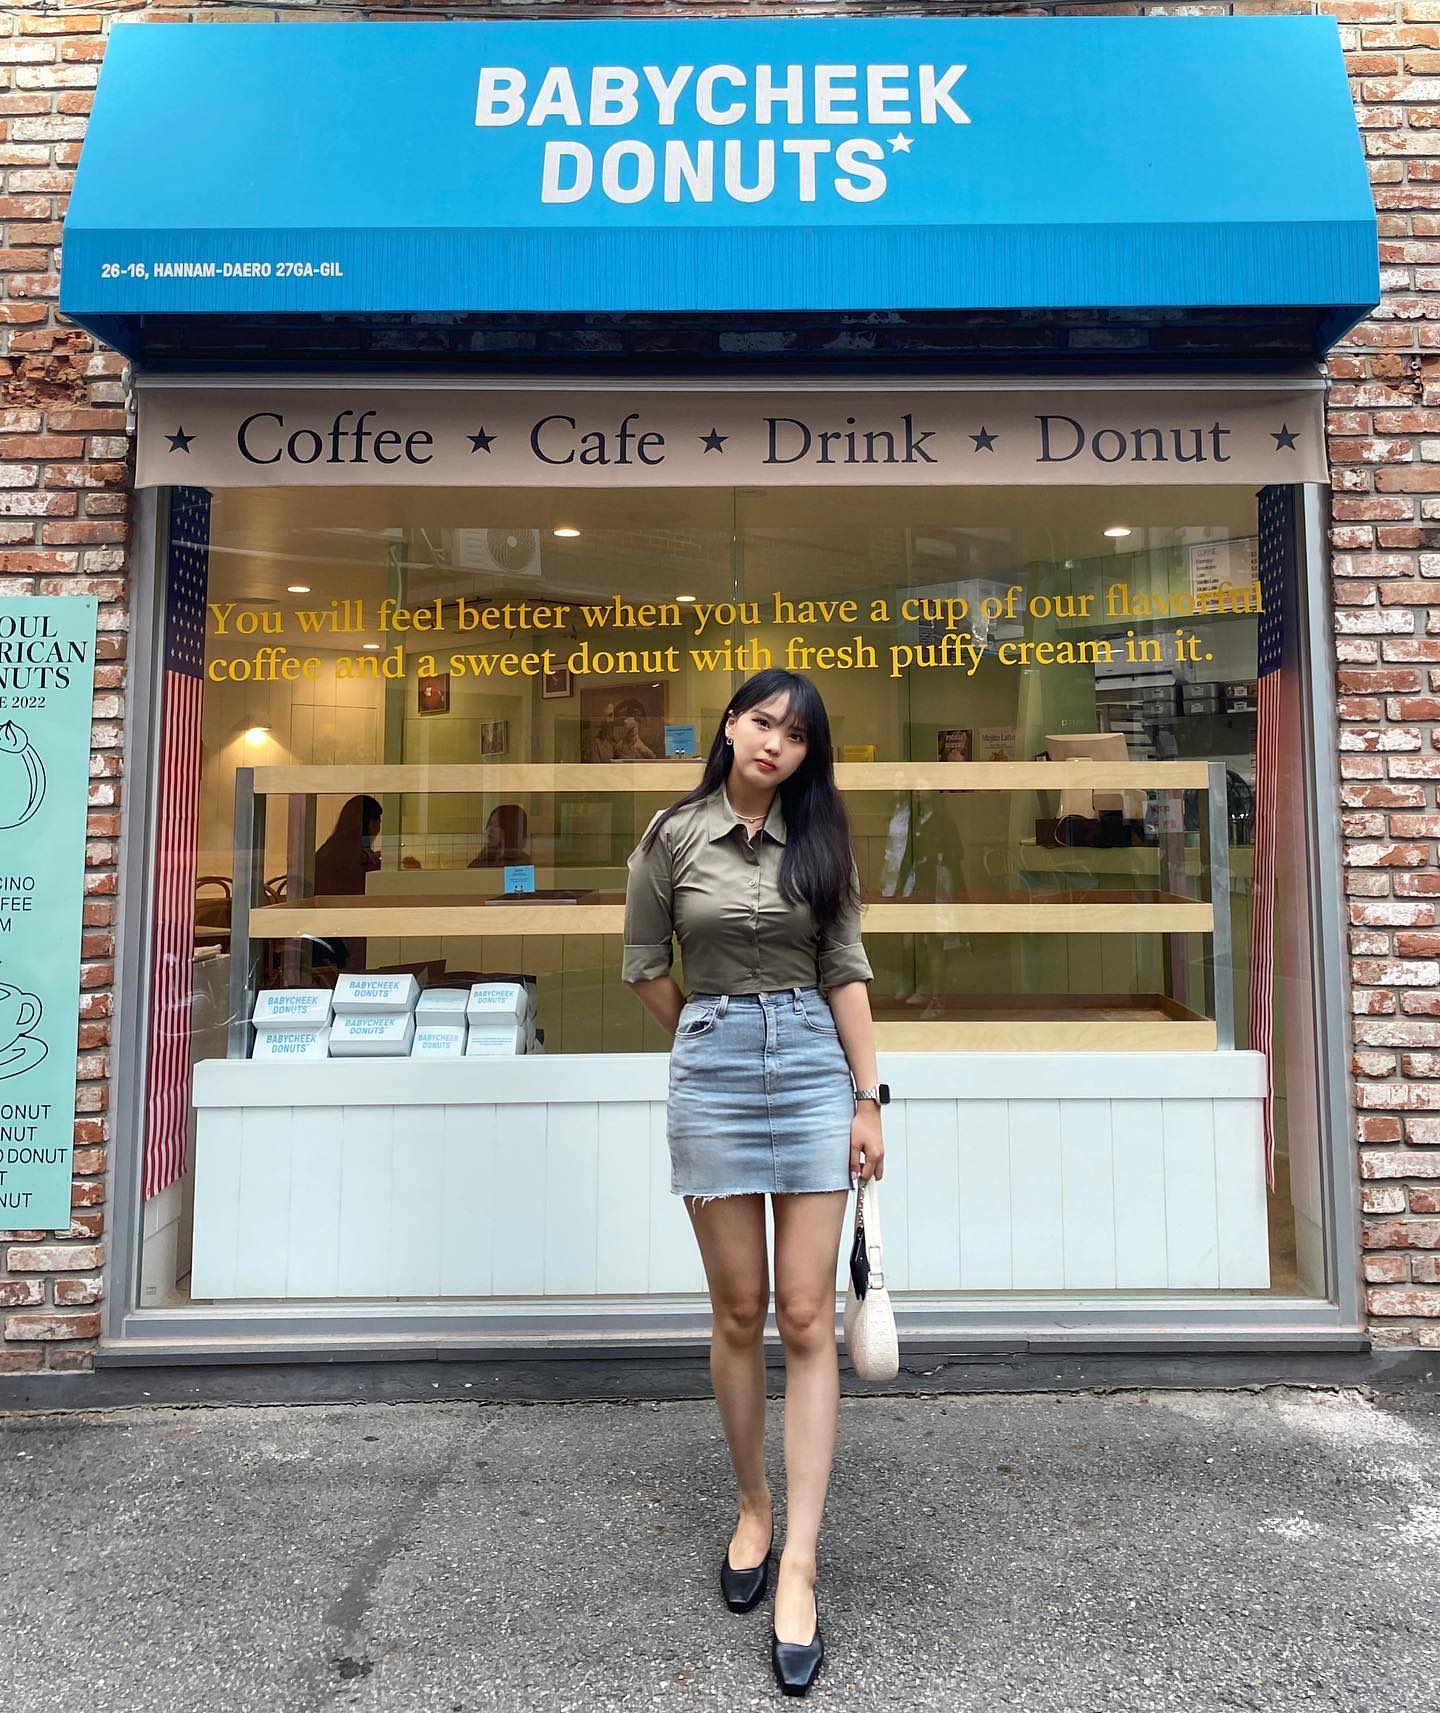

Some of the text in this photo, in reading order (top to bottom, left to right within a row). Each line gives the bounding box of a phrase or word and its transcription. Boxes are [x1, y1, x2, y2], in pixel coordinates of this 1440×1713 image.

[475, 65, 971, 126] BABYCHEEK
[541, 139, 887, 203] DONUTS
[101, 262, 343, 280] 26-16, HANNAM-DAERO 27GA-GIL
[237, 410, 1231, 465] Coffee Cafe Drink Donut
[207, 580, 1265, 636] You will feel better when you have a cup of our flavorful
[0, 616, 58, 638] OUL
[0, 641, 88, 663] RICAN
[208, 628, 1214, 682] coffee and a sweet donut with fresh puffy cream in it.
[12, 696, 46, 708] 2022
[0, 876, 35, 891] INO
[1, 897, 32, 911] FEE
[349, 980, 400, 990] BABYCHEEK
[267, 995, 318, 1005] BABYCHEEK
[354, 988, 390, 998] DONUTS
[473, 990, 515, 998] BABYCHEEK
[273, 1004, 308, 1014] DONUTS
[344, 1018, 395, 1027] BABYCHEEK
[349, 1025, 385, 1035] DONUTS
[266, 1034, 317, 1044] BABYCHEEK
[271, 1043, 307, 1053] DONUTS
[1, 1104, 52, 1119] ONUT
[0, 1126, 38, 1141] NUT
[8, 1148, 68, 1163] DONUT
